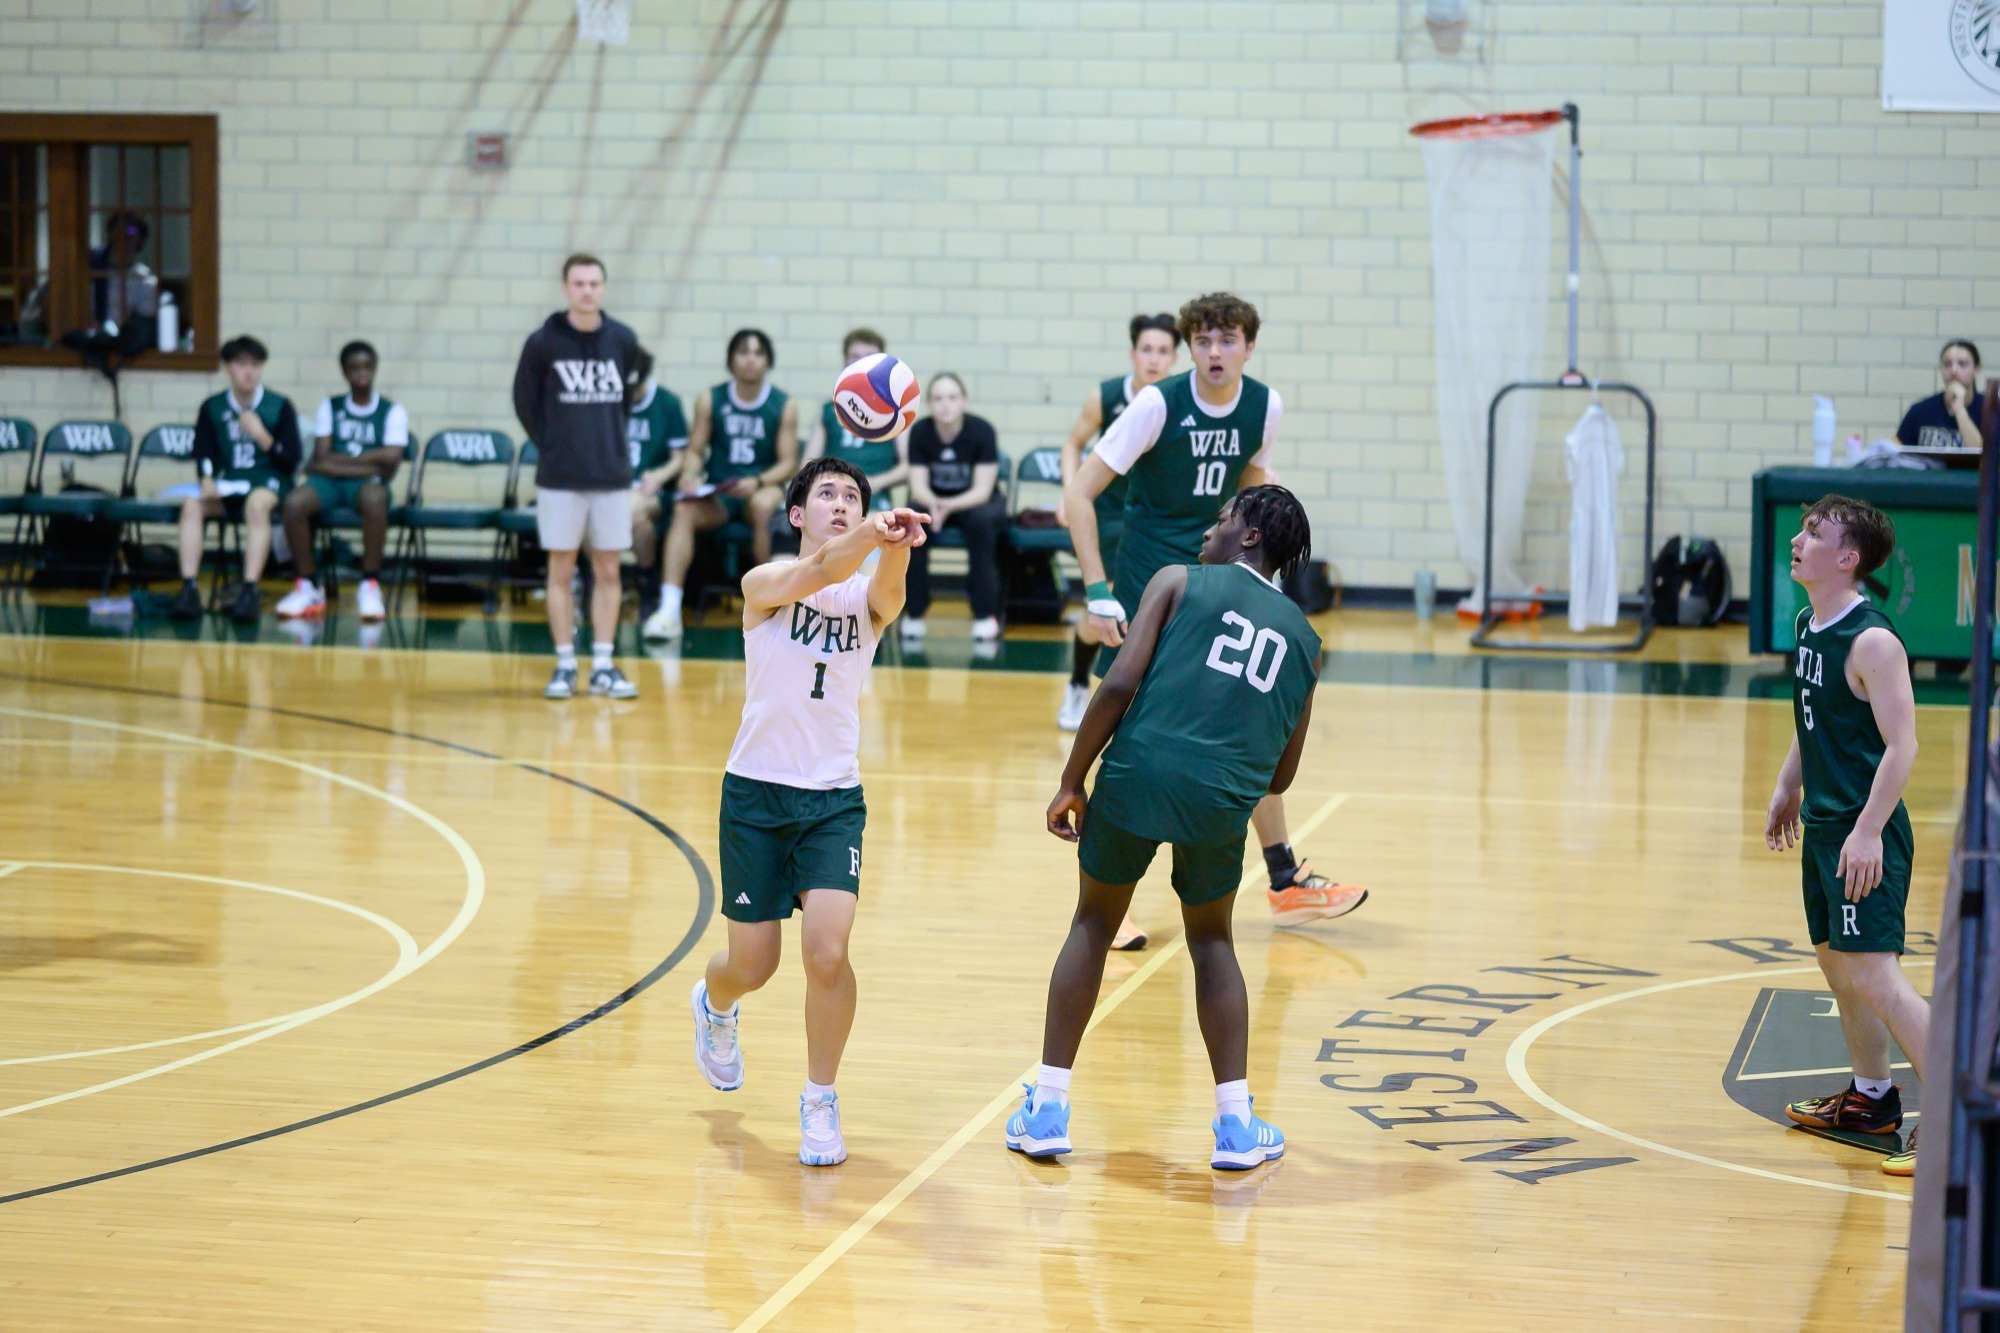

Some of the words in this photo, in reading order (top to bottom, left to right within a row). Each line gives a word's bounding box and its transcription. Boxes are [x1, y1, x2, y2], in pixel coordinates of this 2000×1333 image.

[554, 359, 624, 392] WRA
[62, 424, 115, 451] WRA
[160, 427, 196, 455] WR
[443, 431, 497, 460] WRA
[730, 438, 755, 464] 15
[1189, 428, 1241, 457] WRA
[233, 442, 256, 469] 12
[1192, 461, 1227, 496] 10
[790, 601, 861, 653] WRA
[1206, 610, 1288, 694] 20
[810, 662, 827, 700] 1
[849, 846, 860, 879] R
[1841, 904, 1860, 935] R
[1315, 954, 1662, 1185] WESTERN
